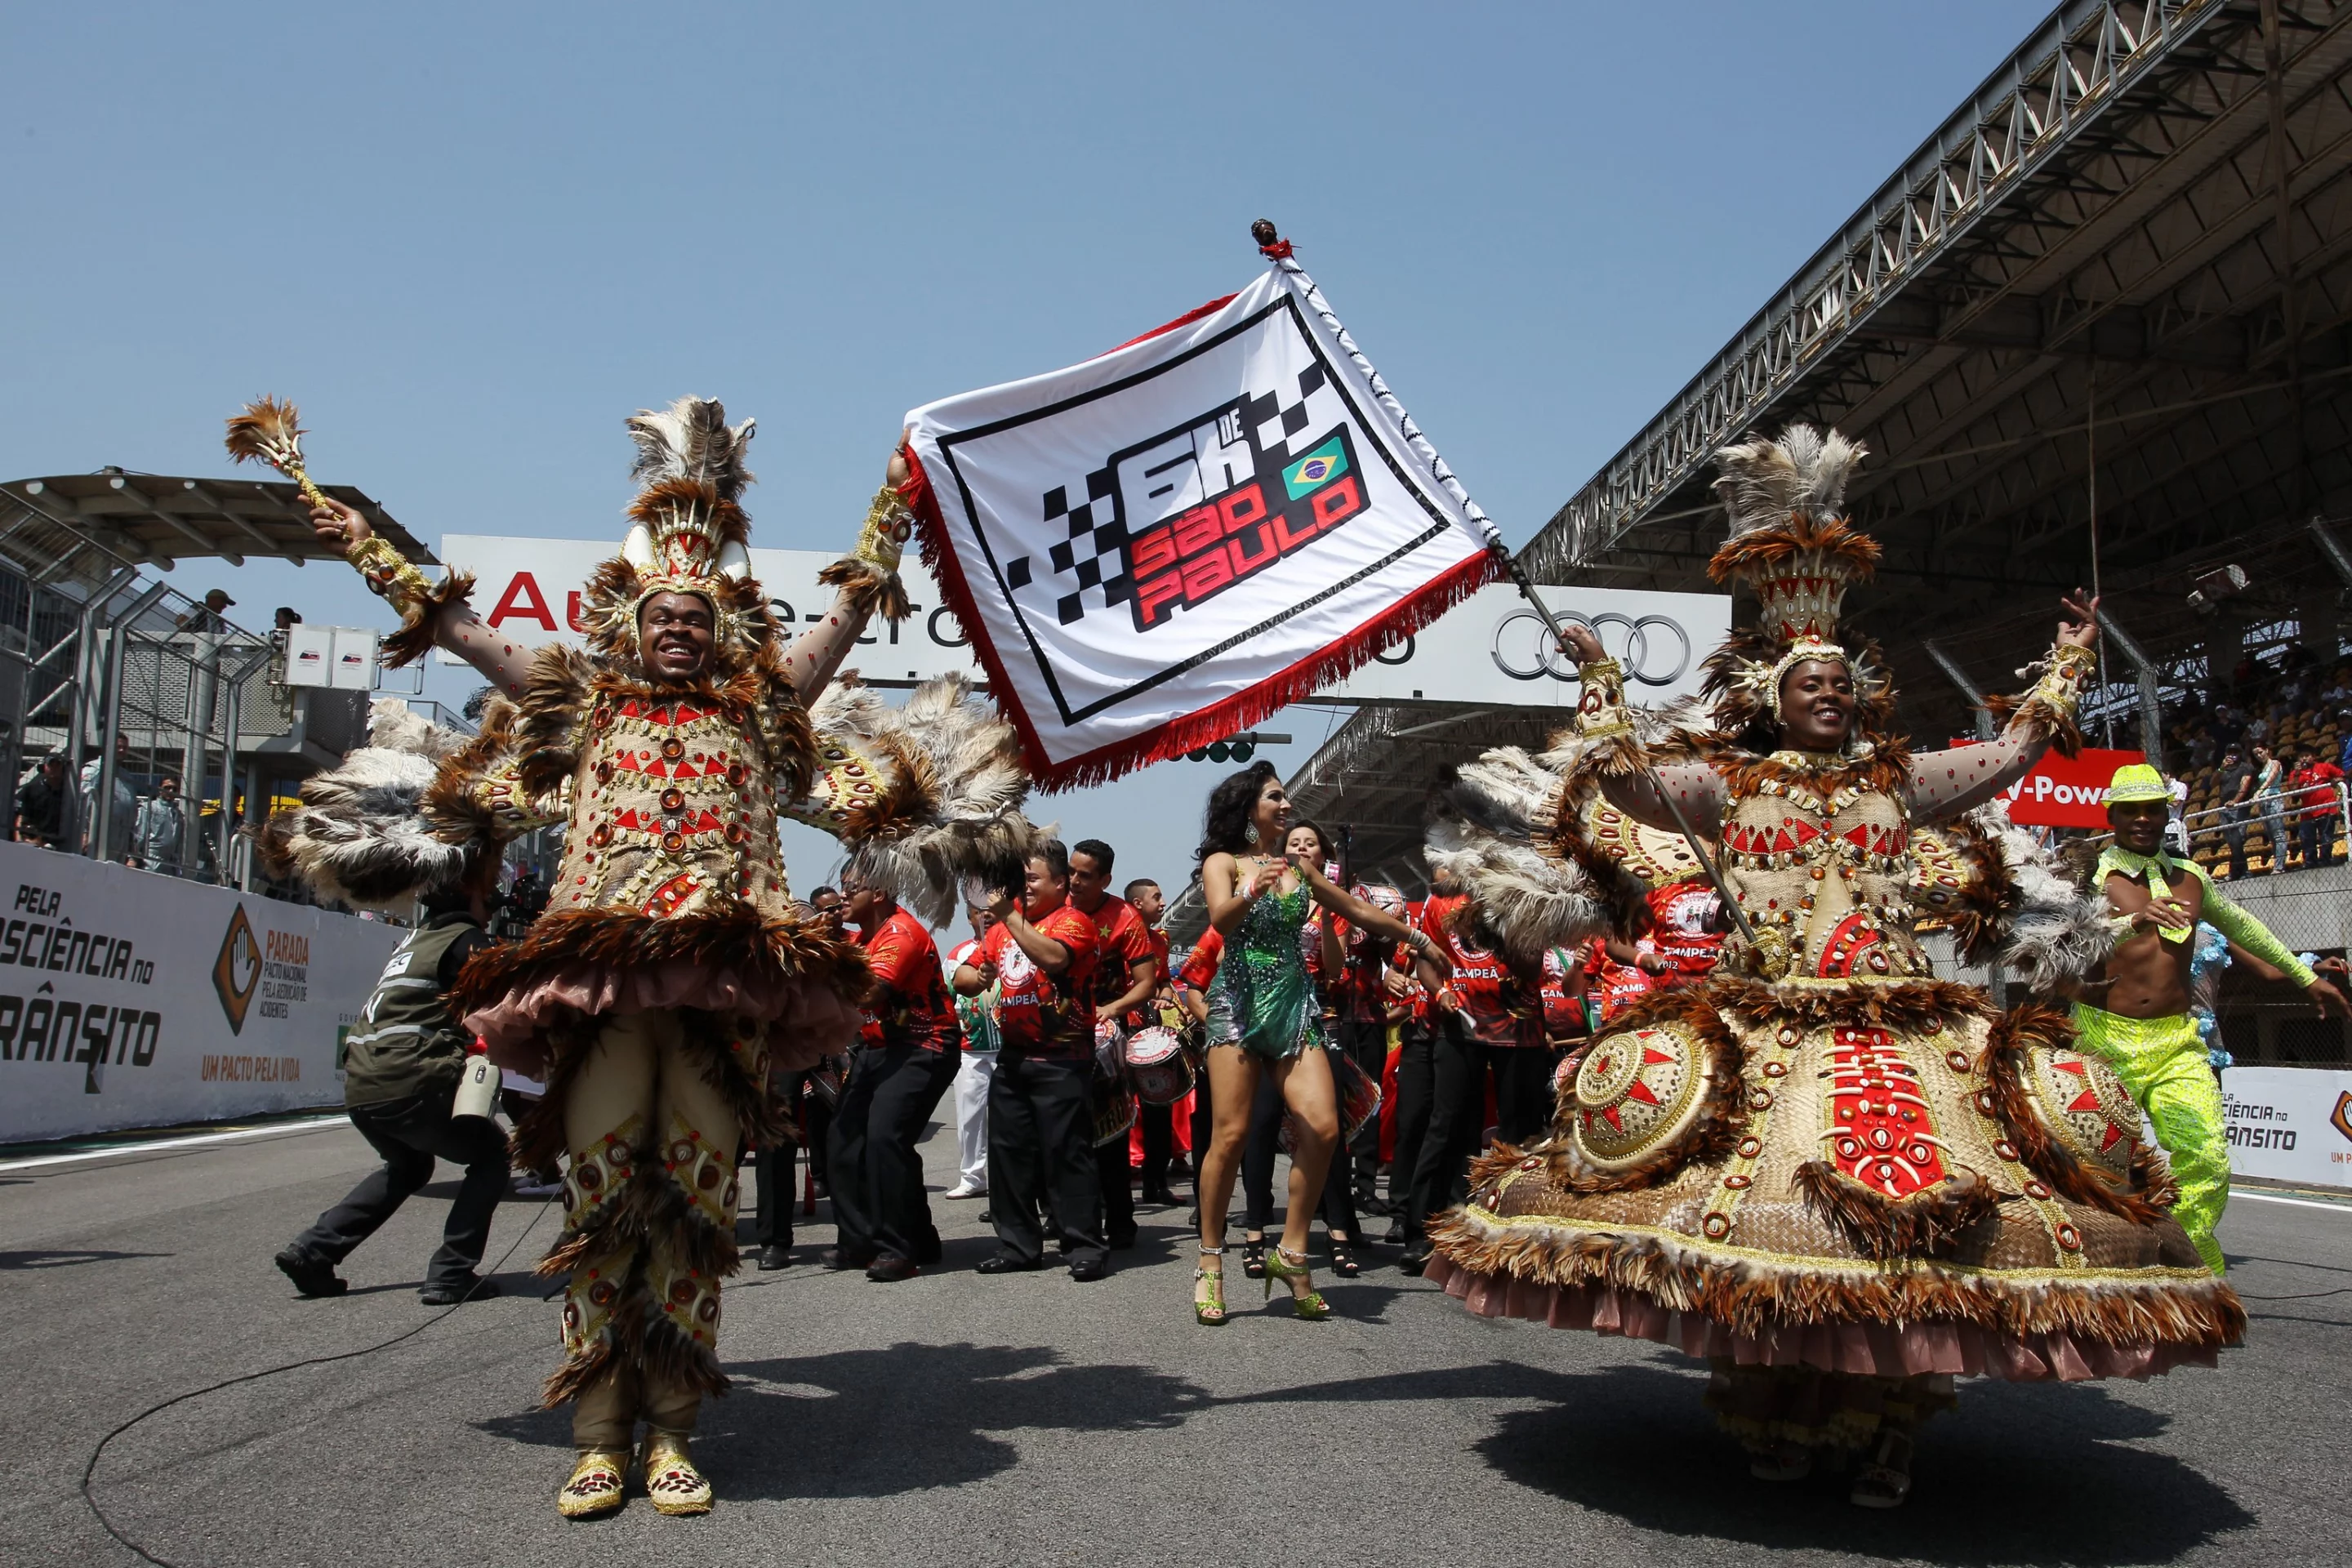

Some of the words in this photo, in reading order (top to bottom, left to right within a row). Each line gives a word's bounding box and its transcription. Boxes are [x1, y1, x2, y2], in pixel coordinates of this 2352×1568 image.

[1218, 408, 1245, 447] DE
[14, 884, 61, 918] PELA
[0, 916, 132, 980] SCIÊNCIA
[265, 929, 309, 966] PARADA
[264, 961, 282, 980] PACTO
[283, 964, 307, 983] NACIONAL
[1456, 966, 1499, 978] CAMPEÃ
[1663, 960, 1678, 969] 012
[261, 981, 275, 998] PELA
[300, 986, 308, 1002] DE
[1542, 989, 1565, 999] CAM
[1618, 983, 1646, 992] CAMP
[259, 1001, 289, 1019] ACIDENTES
[1000, 991, 1039, 1008] AMPEÃ
[1610, 997, 1629, 1007] 2012
[0, 980, 162, 1067] RÂNSITO
[201, 1054, 219, 1082] UM
[220, 1054, 252, 1082] PACTO
[254, 1056, 278, 1082] PELA
[281, 1057, 300, 1082] VIDA
[2225, 1120, 2297, 1152] ÂNSITO
[2331, 1152, 2344, 1164] UM
